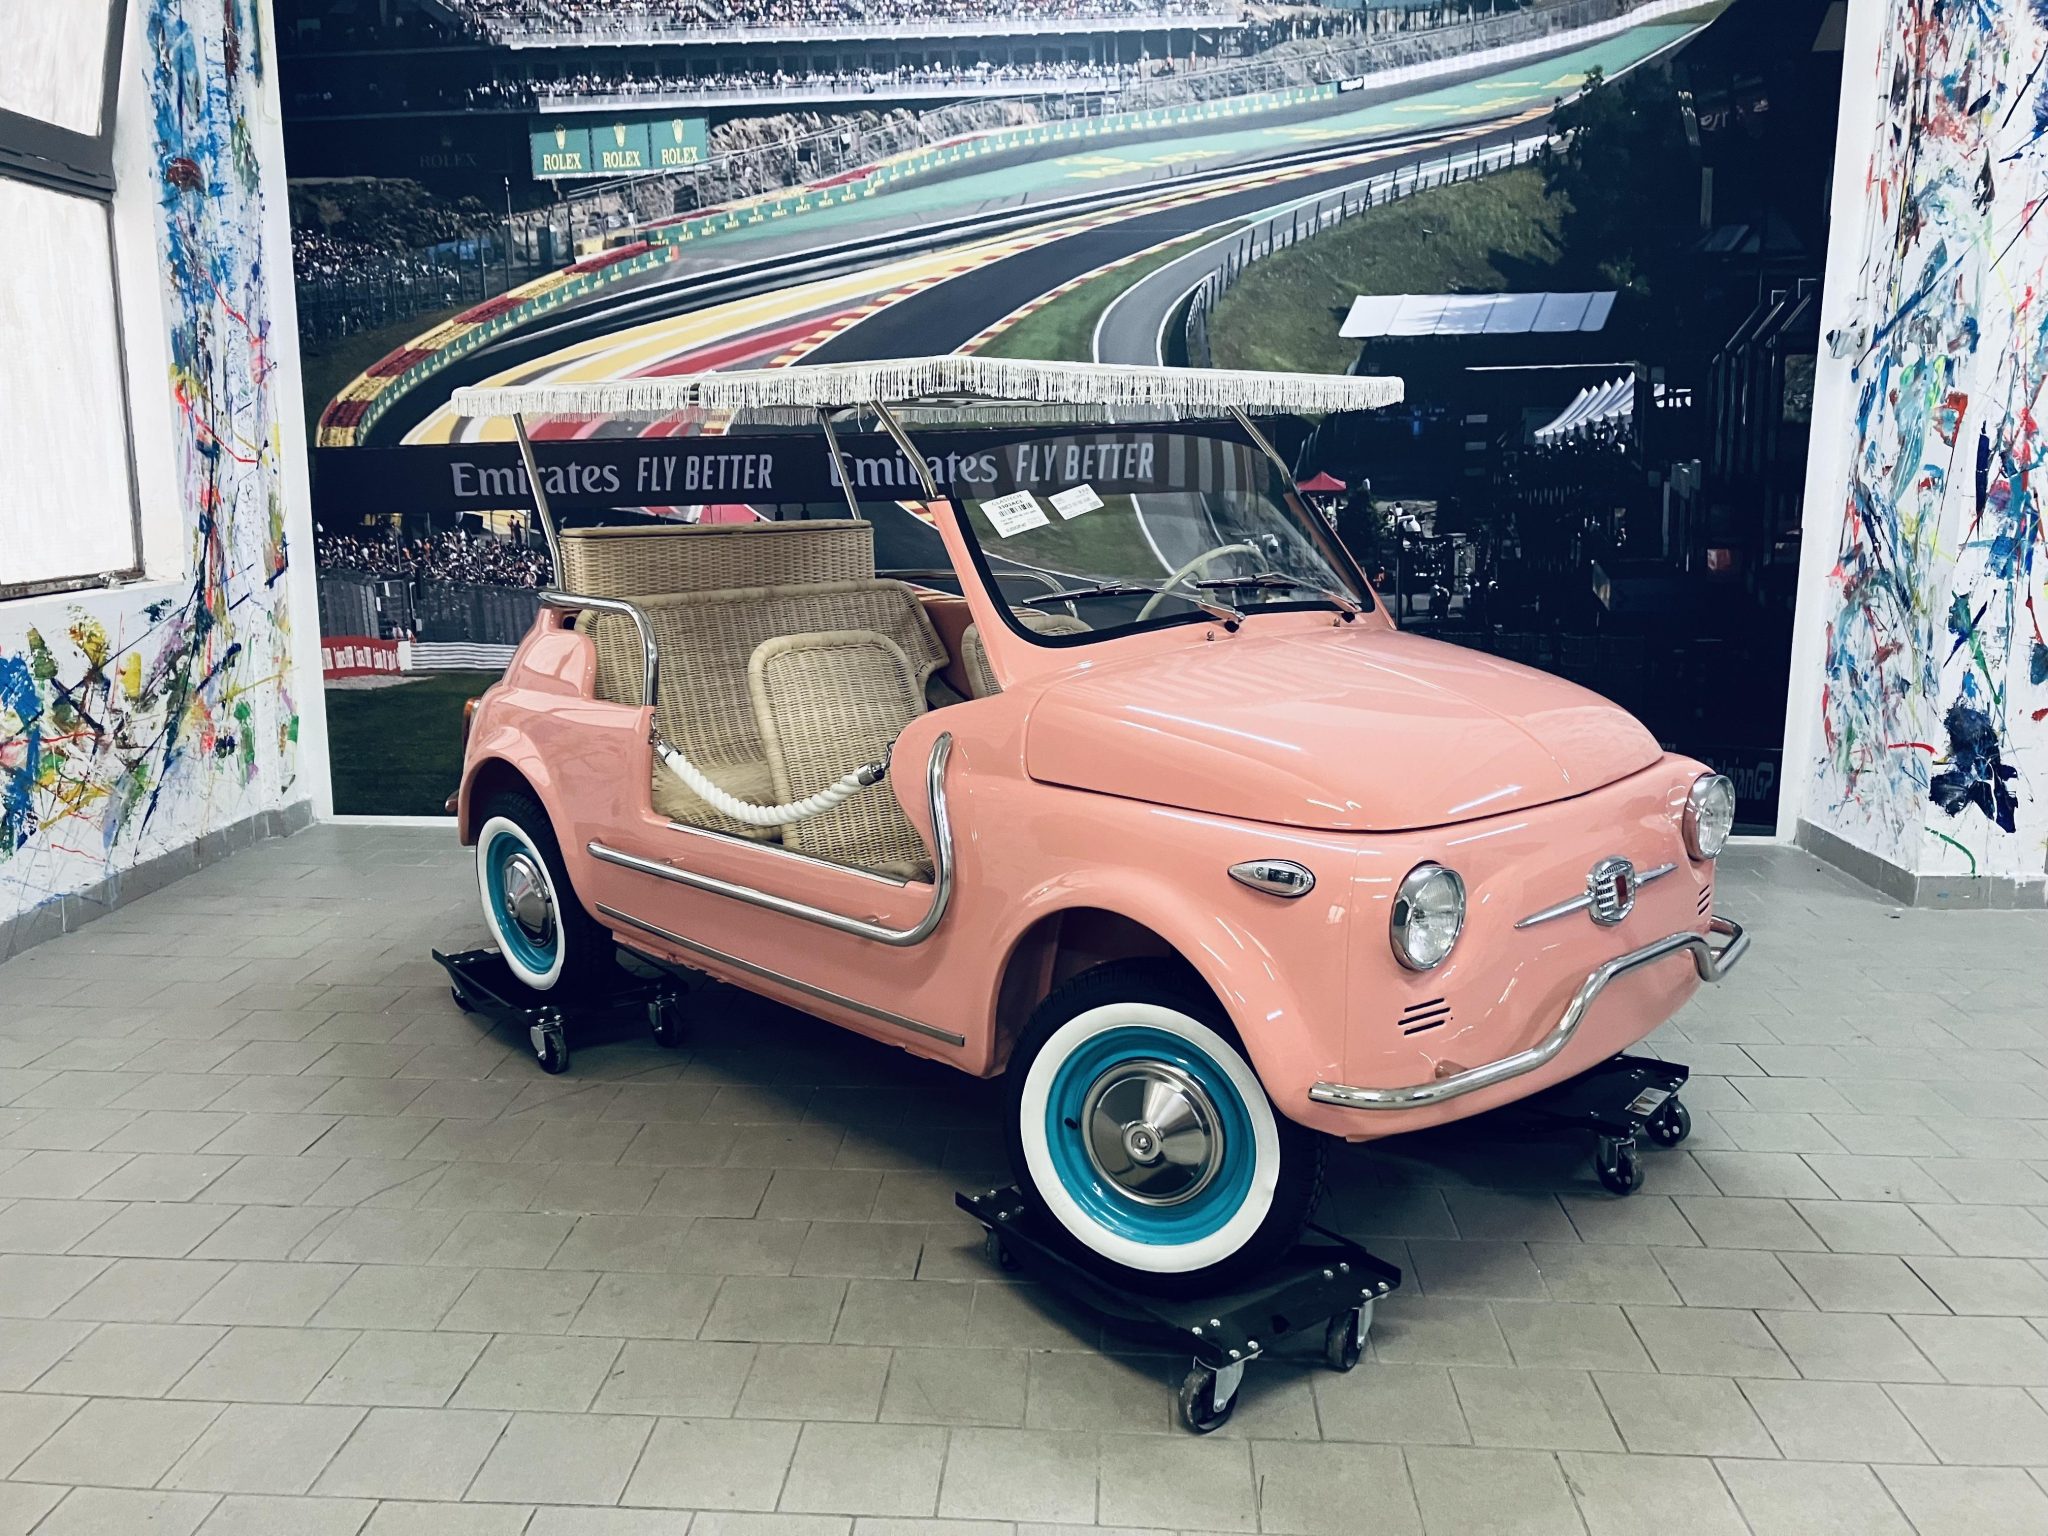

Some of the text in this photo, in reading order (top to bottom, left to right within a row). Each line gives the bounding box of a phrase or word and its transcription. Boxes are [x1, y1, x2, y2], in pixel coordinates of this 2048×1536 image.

[419, 153, 478, 168] ROLEX
[543, 153, 582, 171] ROLEX
[602, 151, 641, 168] ROLEX
[661, 147, 699, 165] ROLEX
[1016, 444, 1056, 482] FLY
[1064, 443, 1155, 481] BETTER
[637, 455, 678, 492] FLY
[685, 454, 774, 491] BETTER
